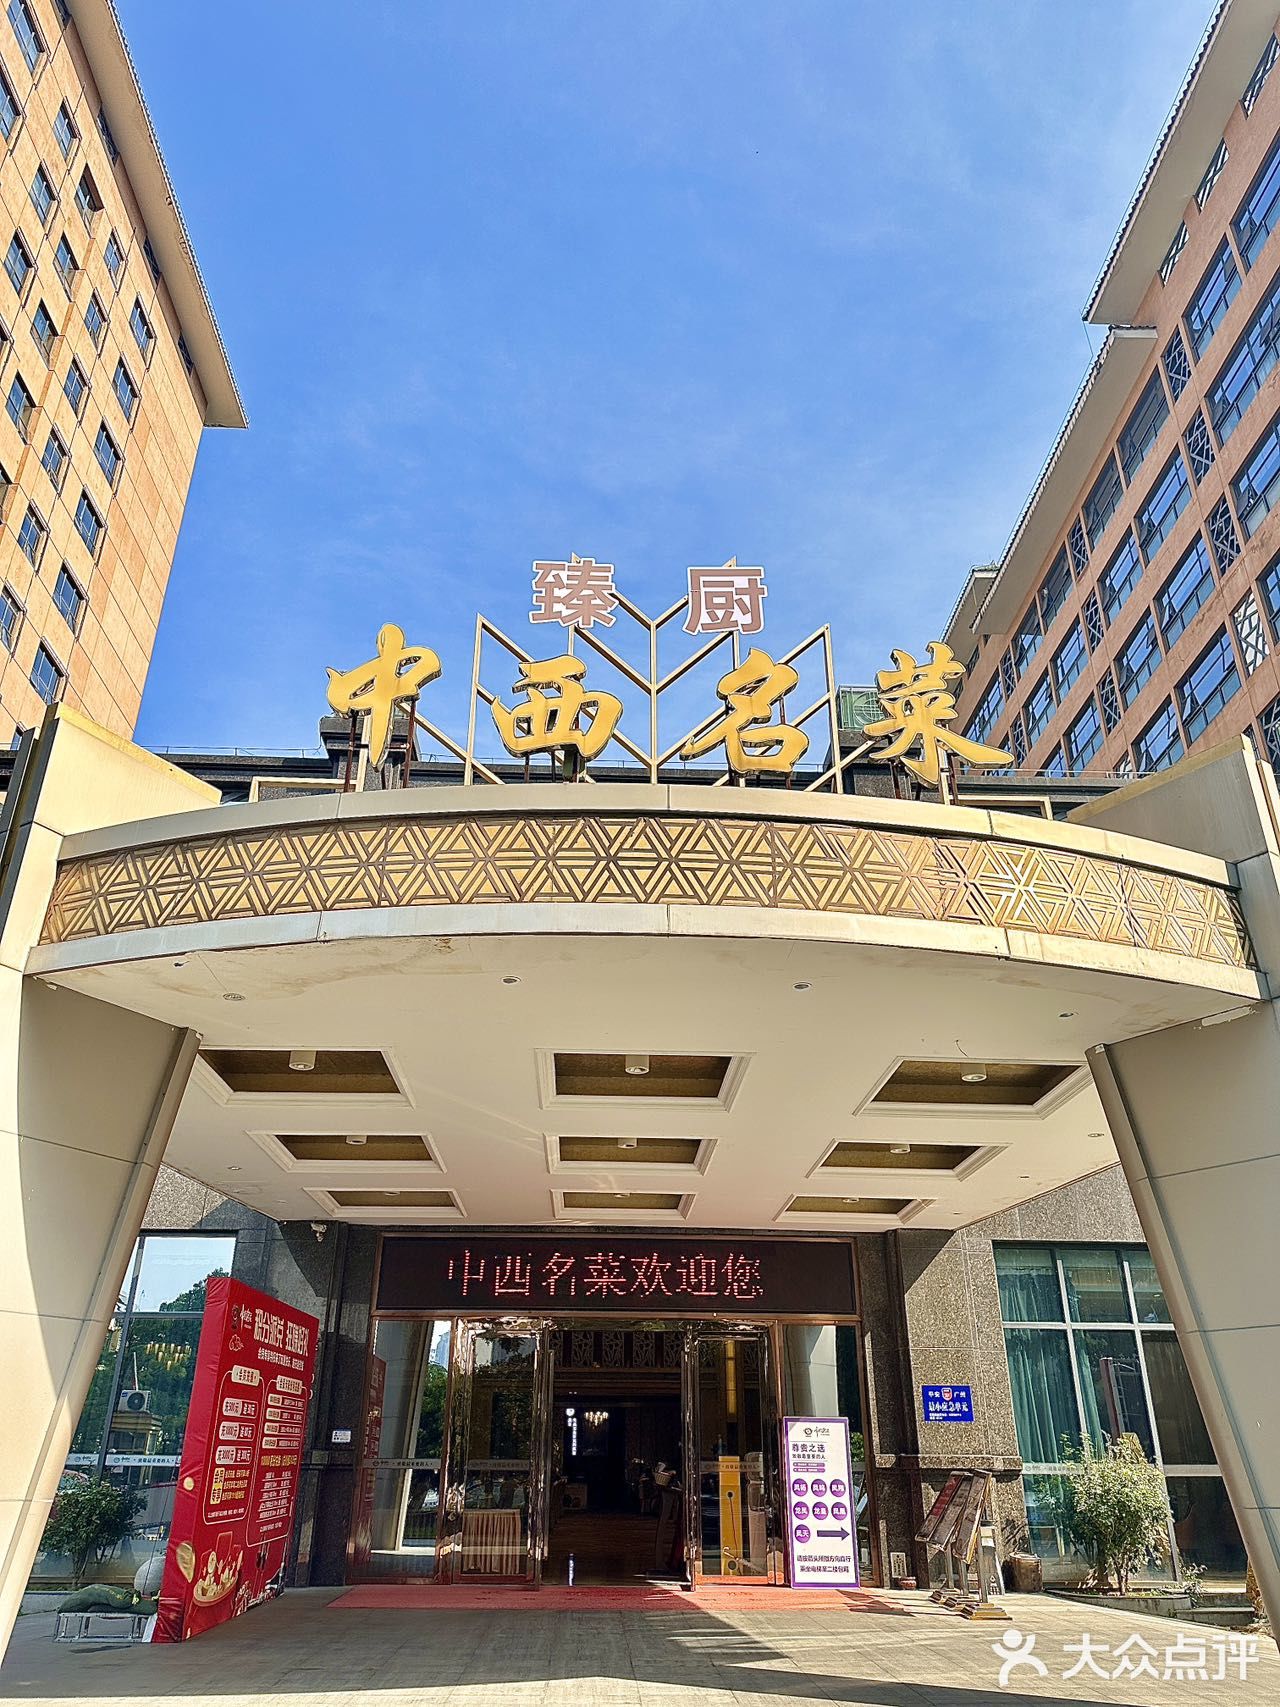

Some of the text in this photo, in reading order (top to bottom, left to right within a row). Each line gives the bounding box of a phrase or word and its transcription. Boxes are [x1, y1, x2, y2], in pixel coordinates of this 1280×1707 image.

[529, 558, 767, 635] 臻厨
[326, 623, 1014, 789] 中西名菜
[449, 1249, 764, 1300] 中西名菜欢迎您
[792, 1443, 825, 1452] 尊贵之选
